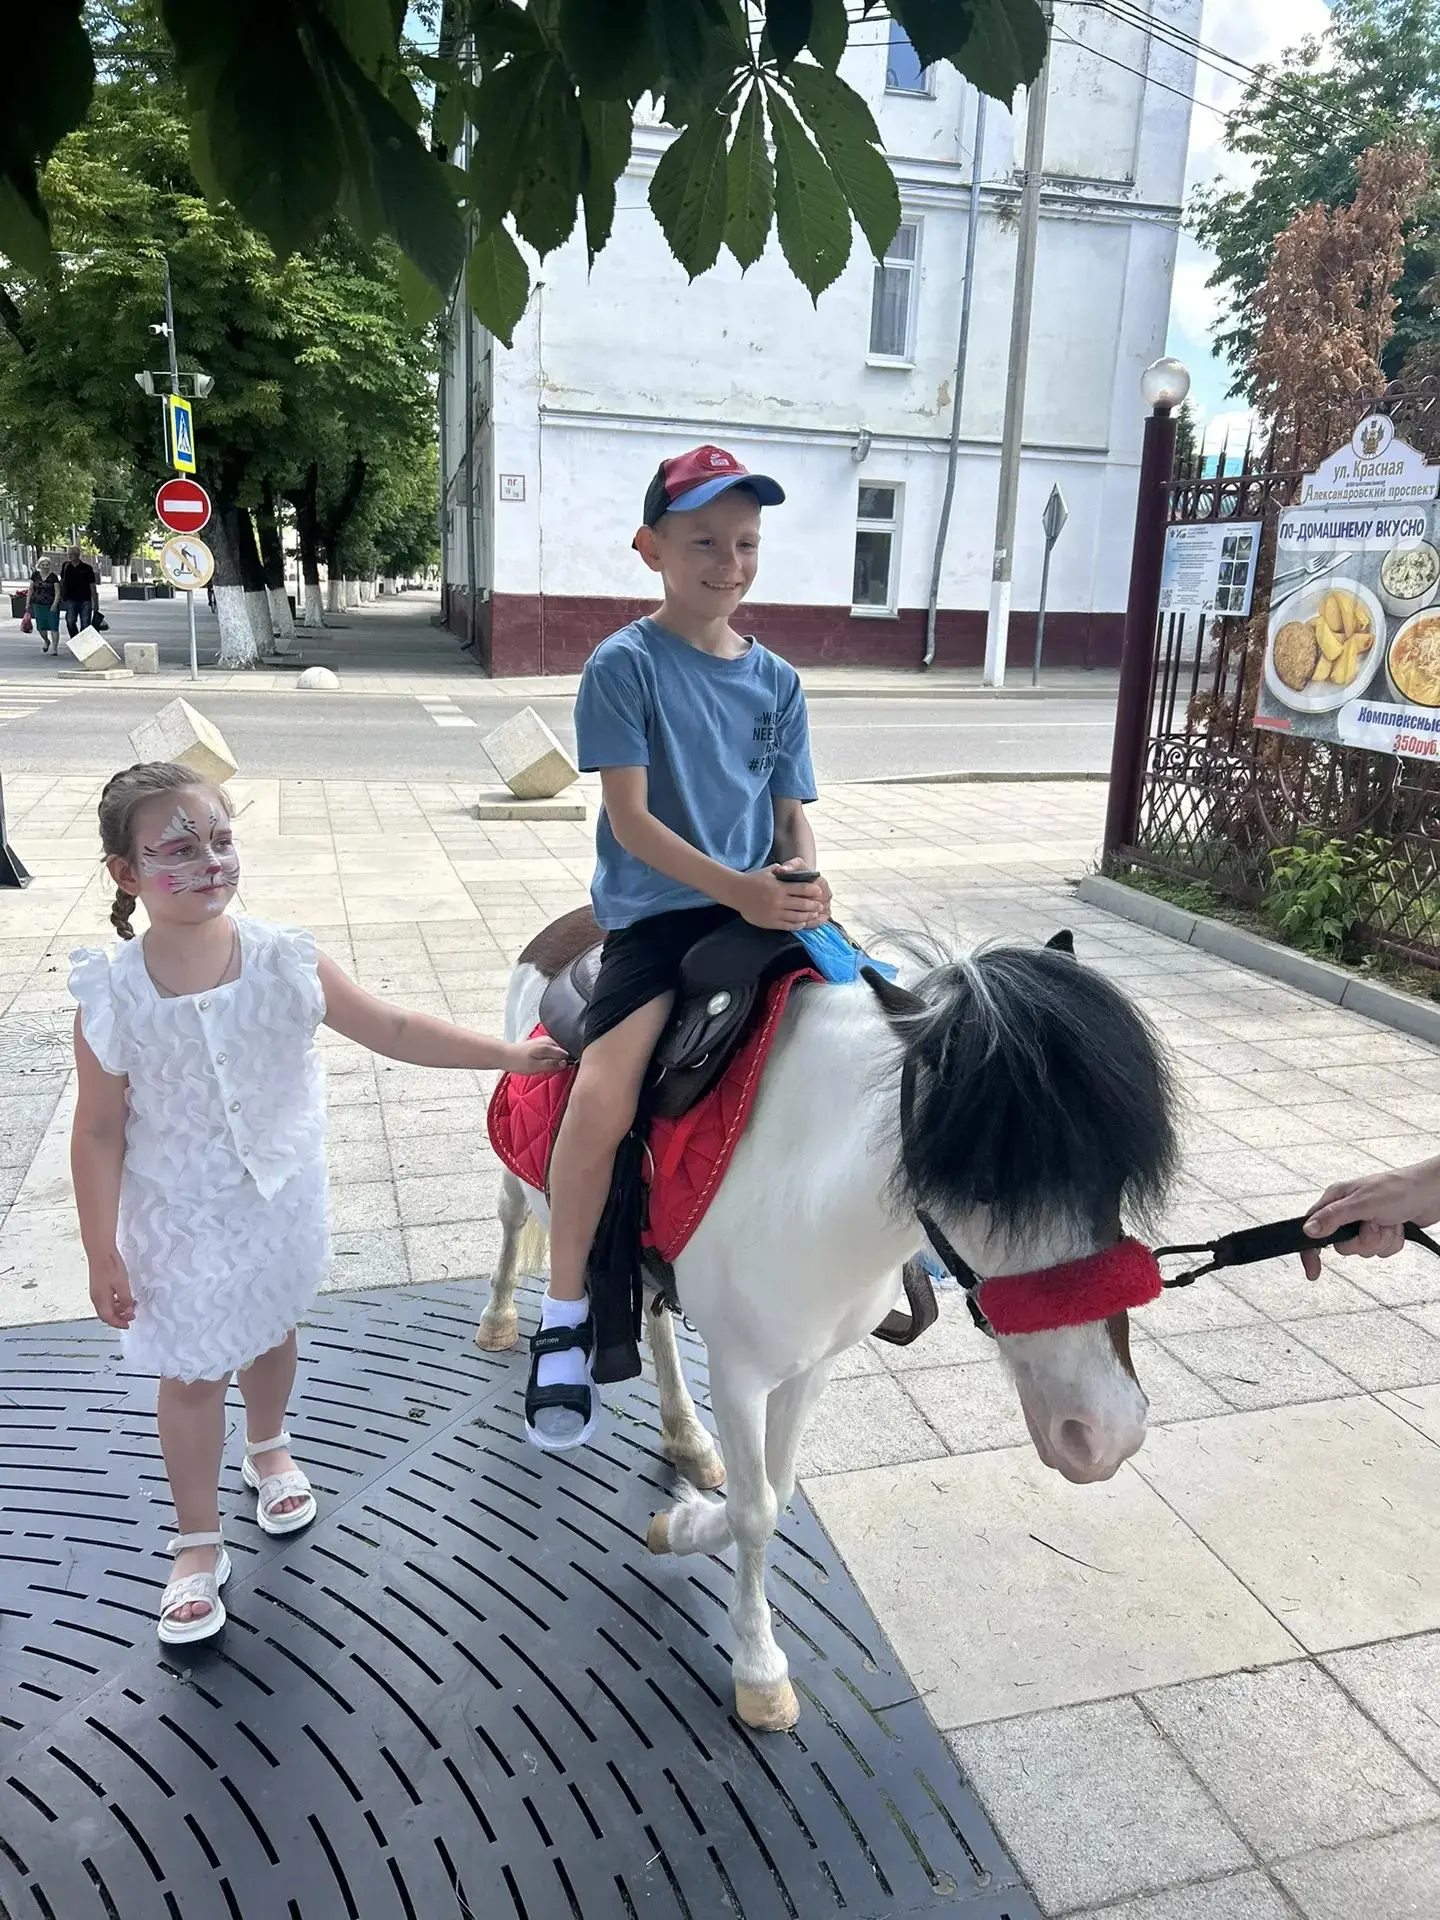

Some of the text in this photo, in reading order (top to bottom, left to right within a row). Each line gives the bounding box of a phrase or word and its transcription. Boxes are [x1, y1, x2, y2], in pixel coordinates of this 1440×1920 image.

[1333, 460, 1404, 483] ул. Красная
[1303, 484, 1436, 502] Александровский проспект
[1279, 518, 1425, 542] ПО-ДОМАШНЕМУ ВКУСНО
[1358, 707, 1440, 732] Комплексные
[1394, 734, 1439, 756] 350руб.
